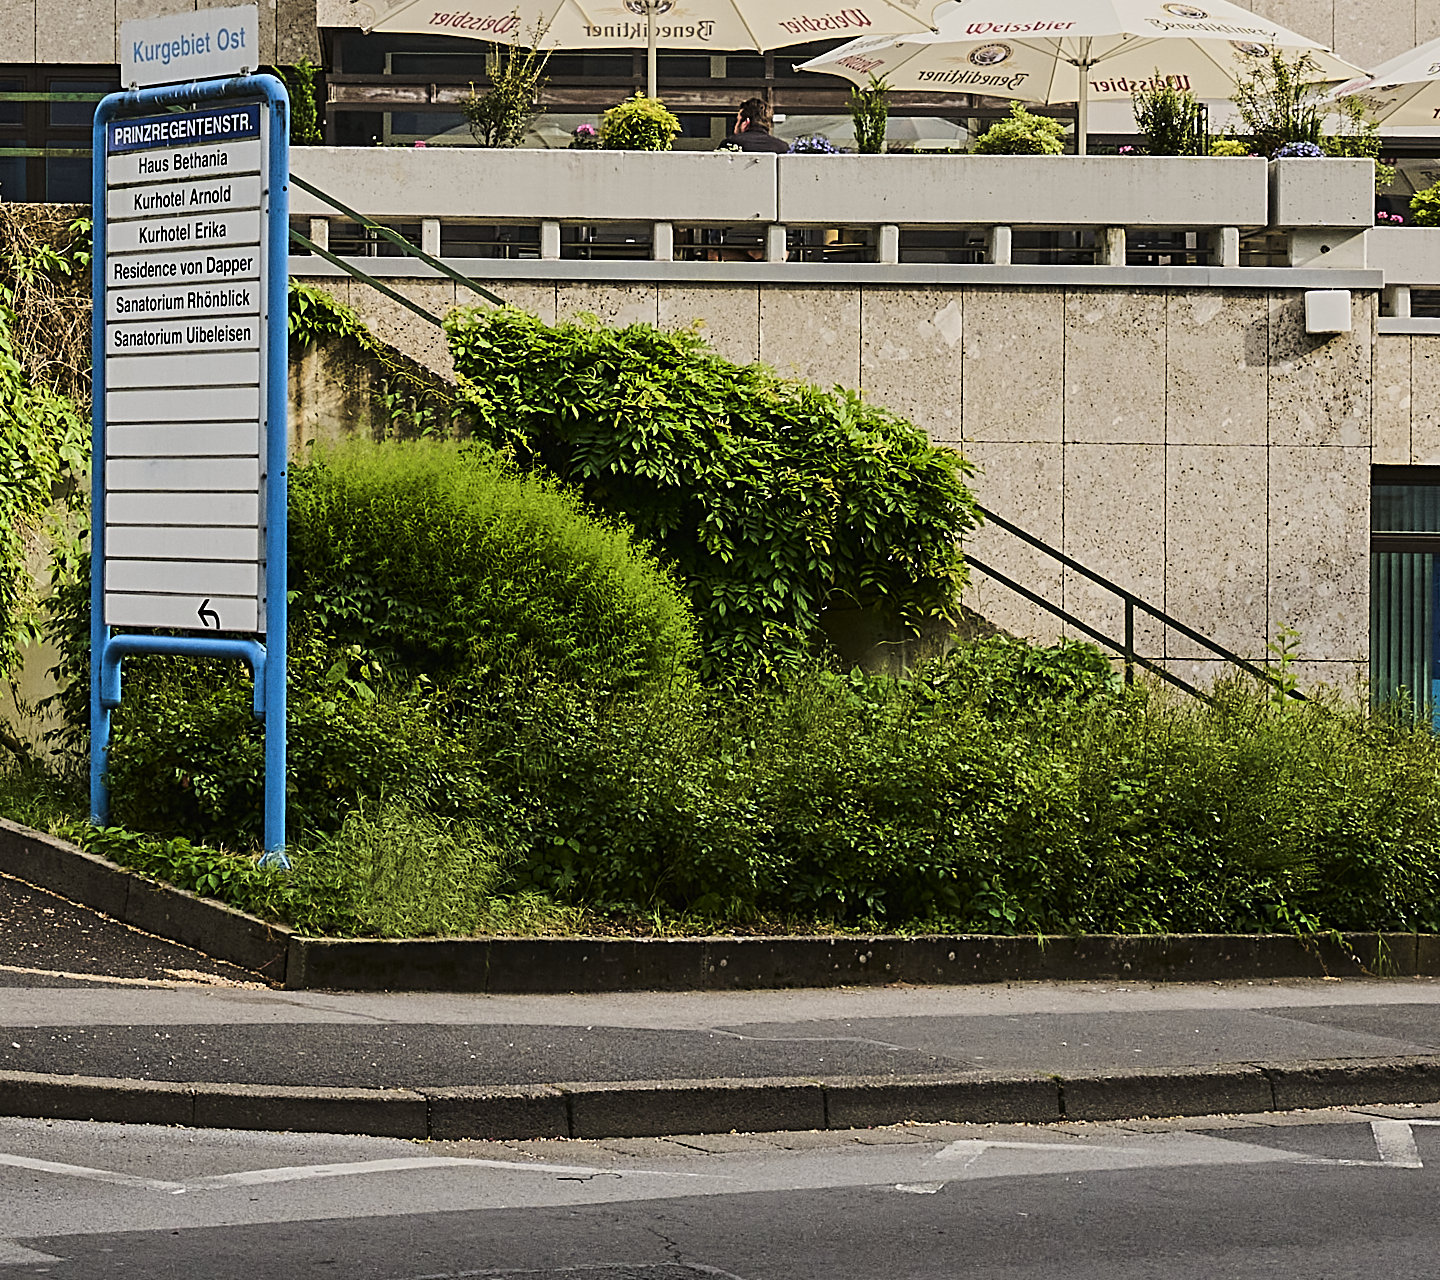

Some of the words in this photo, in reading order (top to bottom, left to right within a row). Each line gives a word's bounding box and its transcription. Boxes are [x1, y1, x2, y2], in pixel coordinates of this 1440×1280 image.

[966, 20, 1077, 35] Weissbier
[133, 32, 210, 65] Kurgebiet
[217, 27, 246, 51] Ost
[114, 113, 253, 146] PRINZREGENTENSTR.
[138, 157, 169, 174] Haus
[173, 150, 228, 171] Bethania
[134, 189, 185, 211] Kurhotel
[190, 185, 231, 206] Arnold
[139, 224, 190, 244] Kurhotel
[195, 221, 227, 239] Erika
[114, 262, 176, 280] Residence
[180, 261, 203, 275] von
[206, 256, 253, 276] Dapper
[116, 294, 184, 314] Sanatorium
[187, 289, 250, 309] Rhönblick
[114, 329, 182, 347] Sanatorium
[186, 325, 251, 343] Uibeleisen
